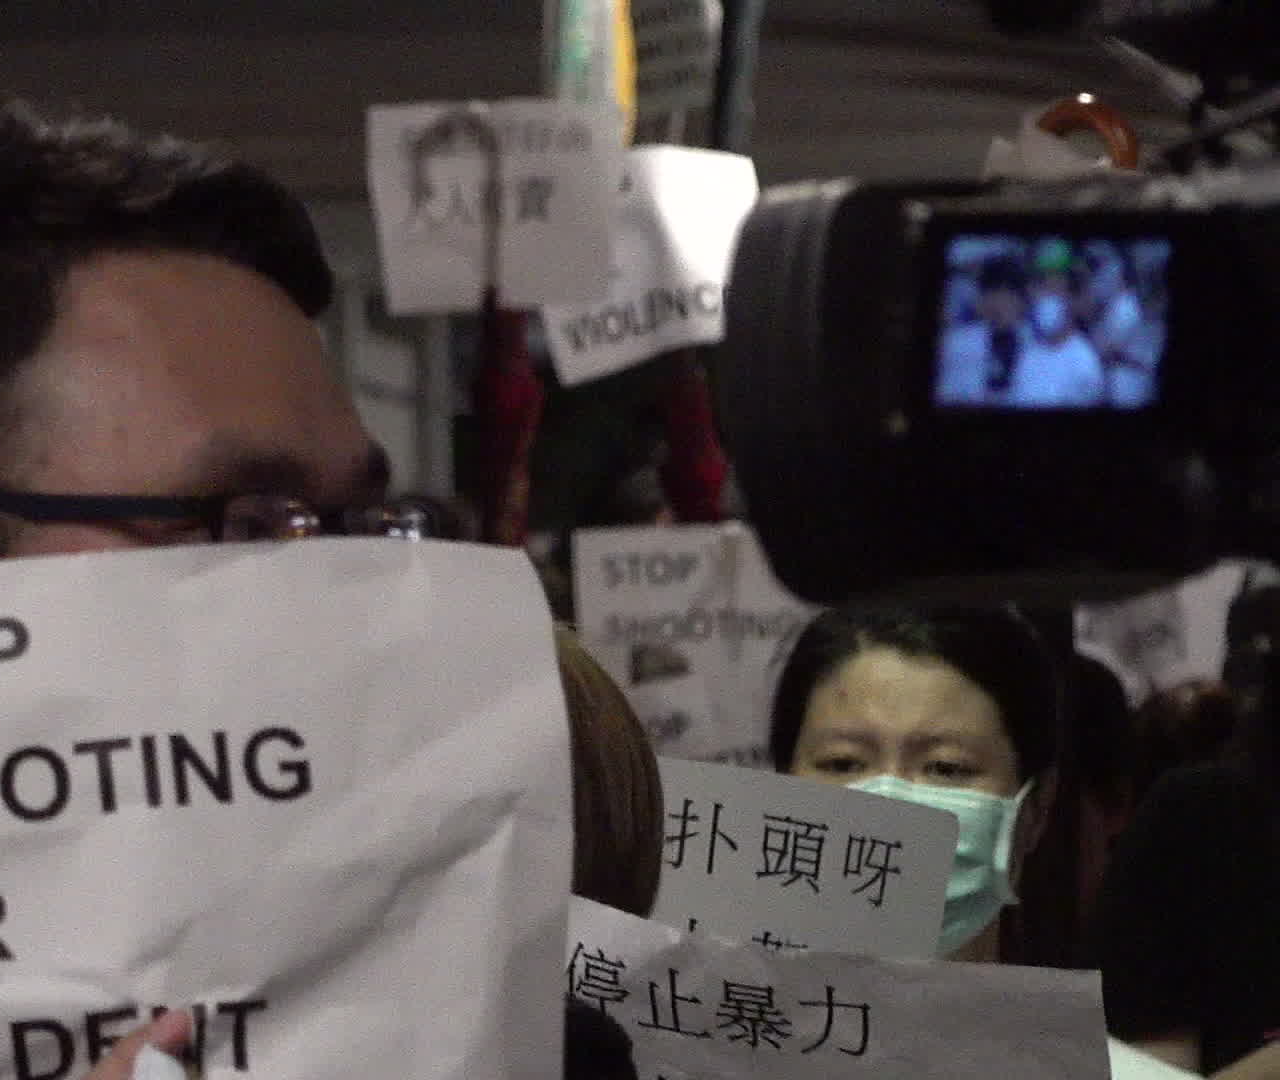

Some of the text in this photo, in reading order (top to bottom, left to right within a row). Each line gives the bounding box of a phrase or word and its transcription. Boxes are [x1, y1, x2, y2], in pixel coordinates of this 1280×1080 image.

[665, 799, 903, 908] 扑頭呀
[566, 942, 872, 1057] 停止暴力
